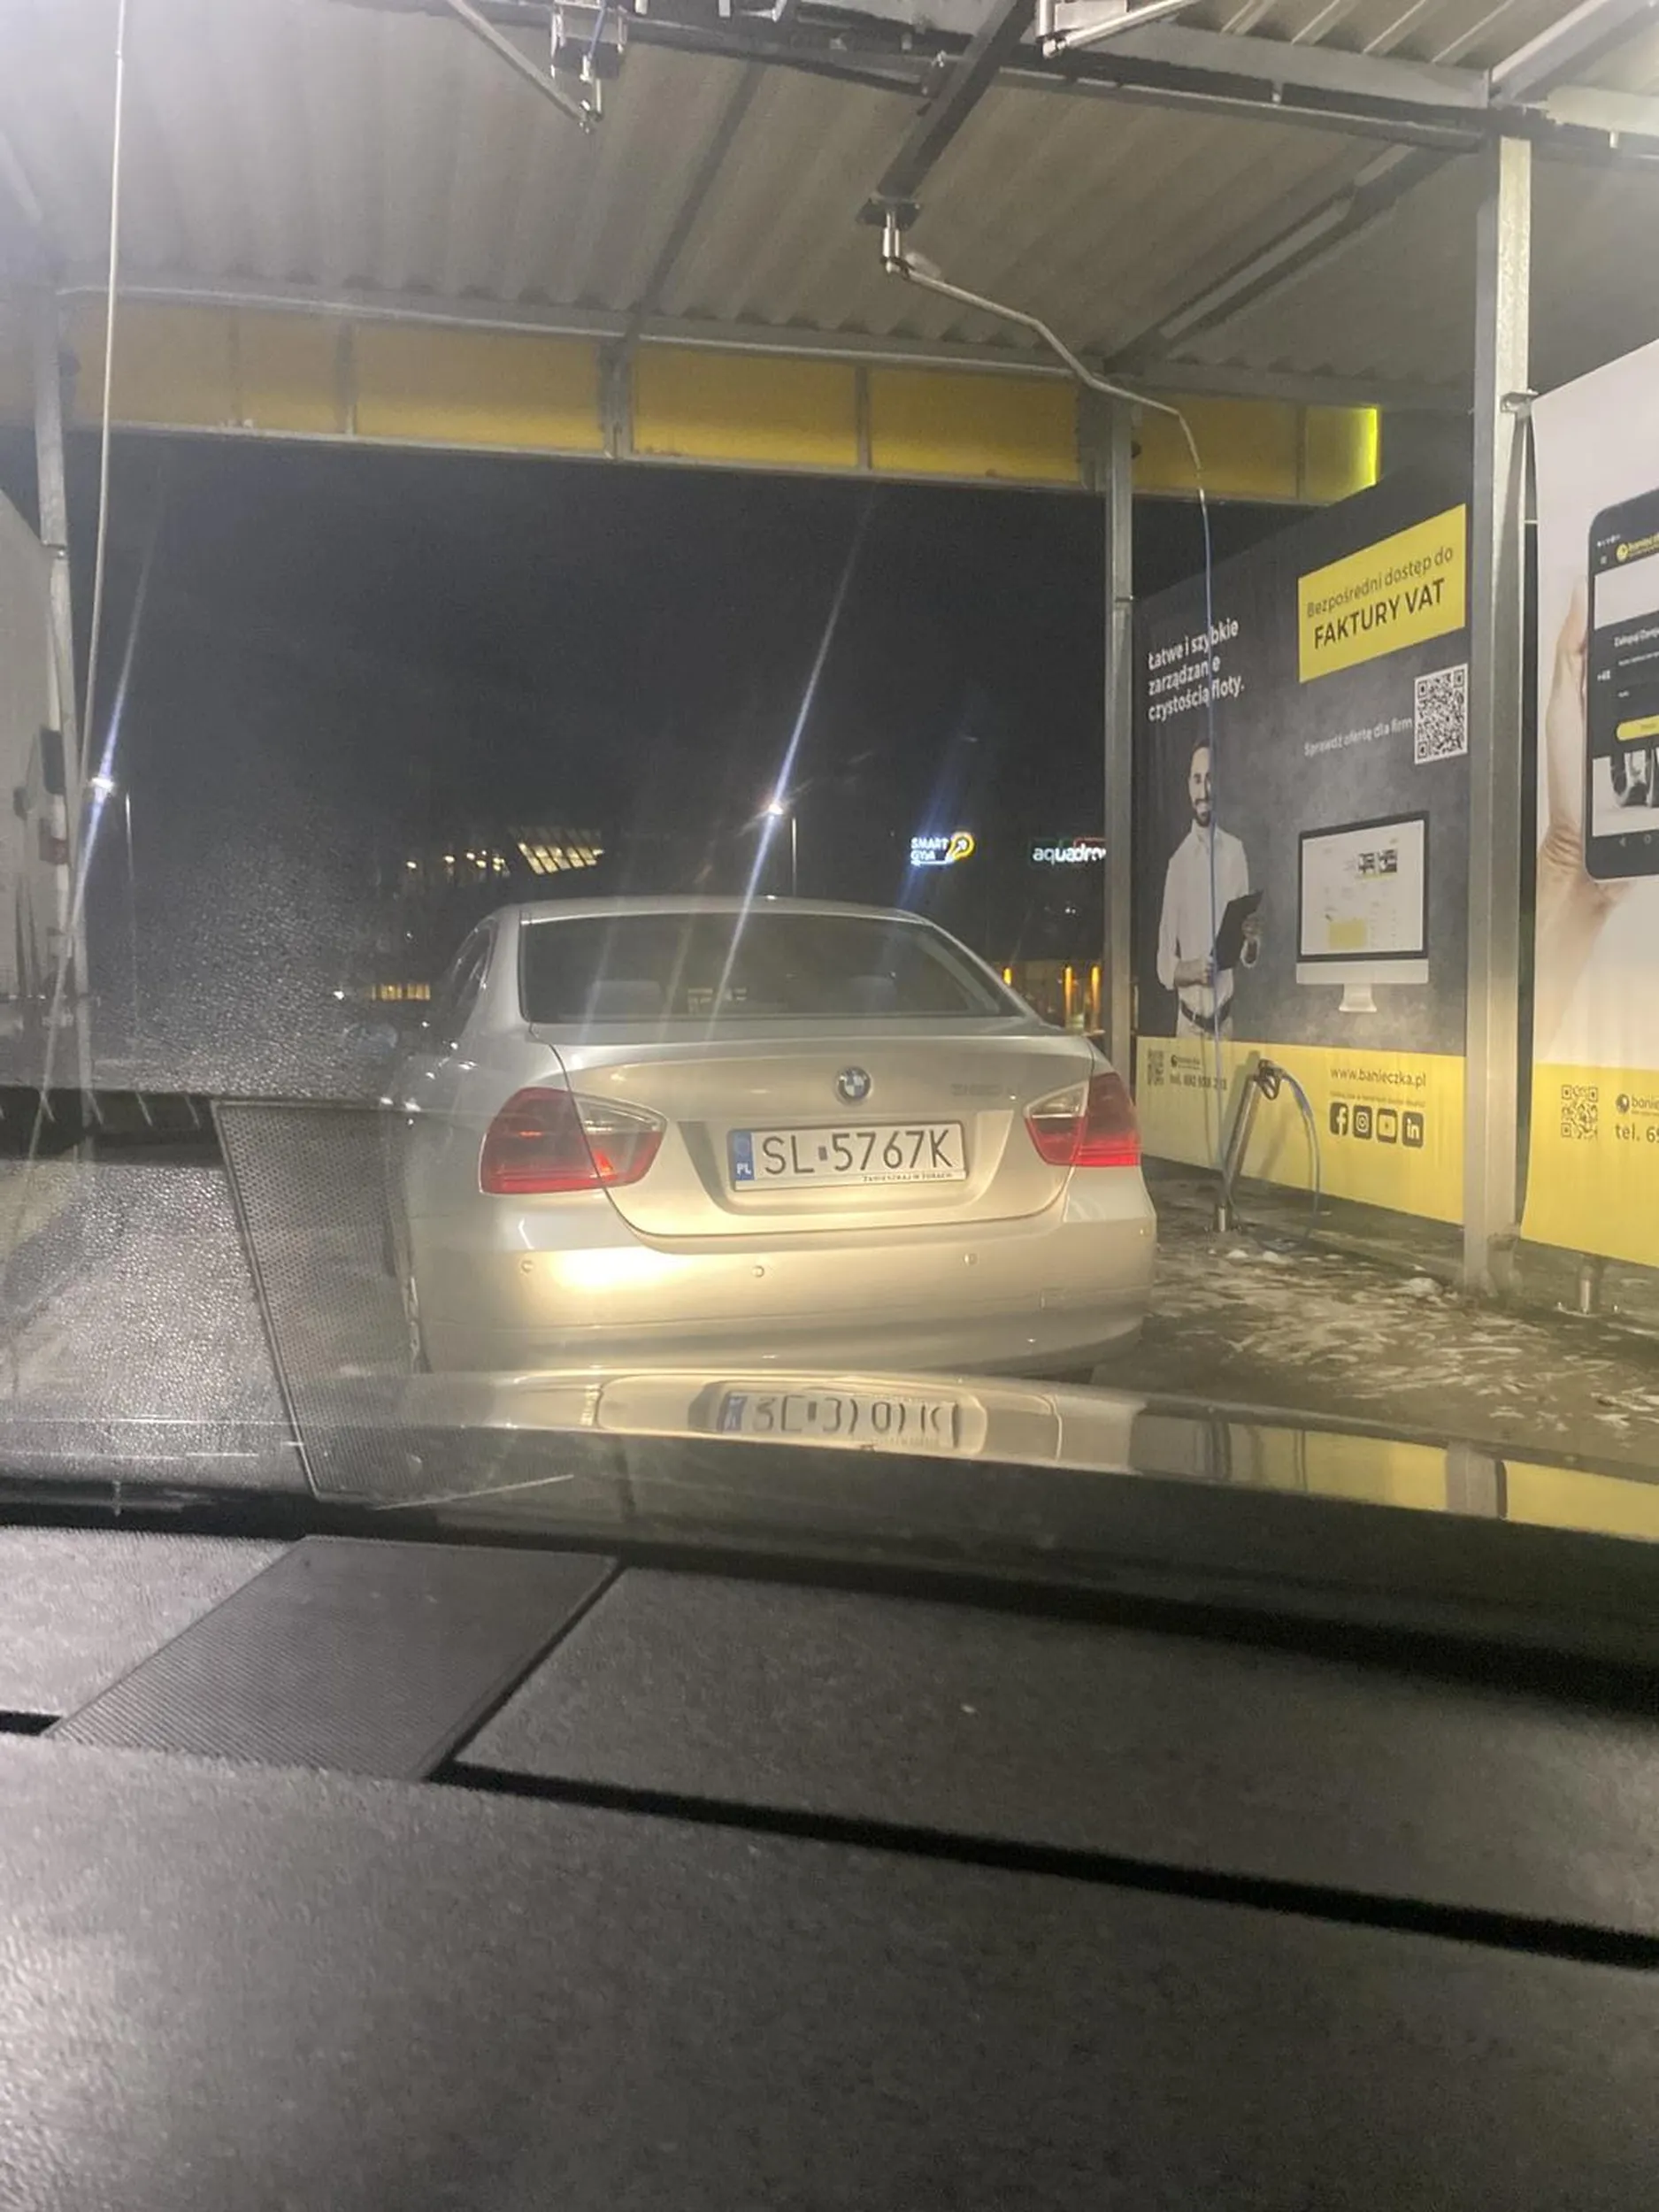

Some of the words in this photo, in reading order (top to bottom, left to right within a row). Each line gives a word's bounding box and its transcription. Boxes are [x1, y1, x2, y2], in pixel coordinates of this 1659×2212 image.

[1307, 572, 1382, 618] Bezpośredni
[1385, 557, 1432, 587] dostęp
[1434, 546, 1454, 567] do
[1314, 594, 1401, 649] FAKTURY
[1405, 577, 1445, 616] VAT
[1185, 634, 1189, 656] i
[1191, 618, 1239, 654] szybkie
[1148, 656, 1220, 695] zarządzane
[1148, 684, 1210, 722] czystością
[910, 837, 949, 849] SMART
[1330, 1068, 1426, 1090] www.banieczka.pl
[1616, 1123, 1640, 1141] tel.
[737, 1162, 751, 1175] PL
[762, 1134, 815, 1175] SL
[832, 1129, 953, 1171] 5767K
